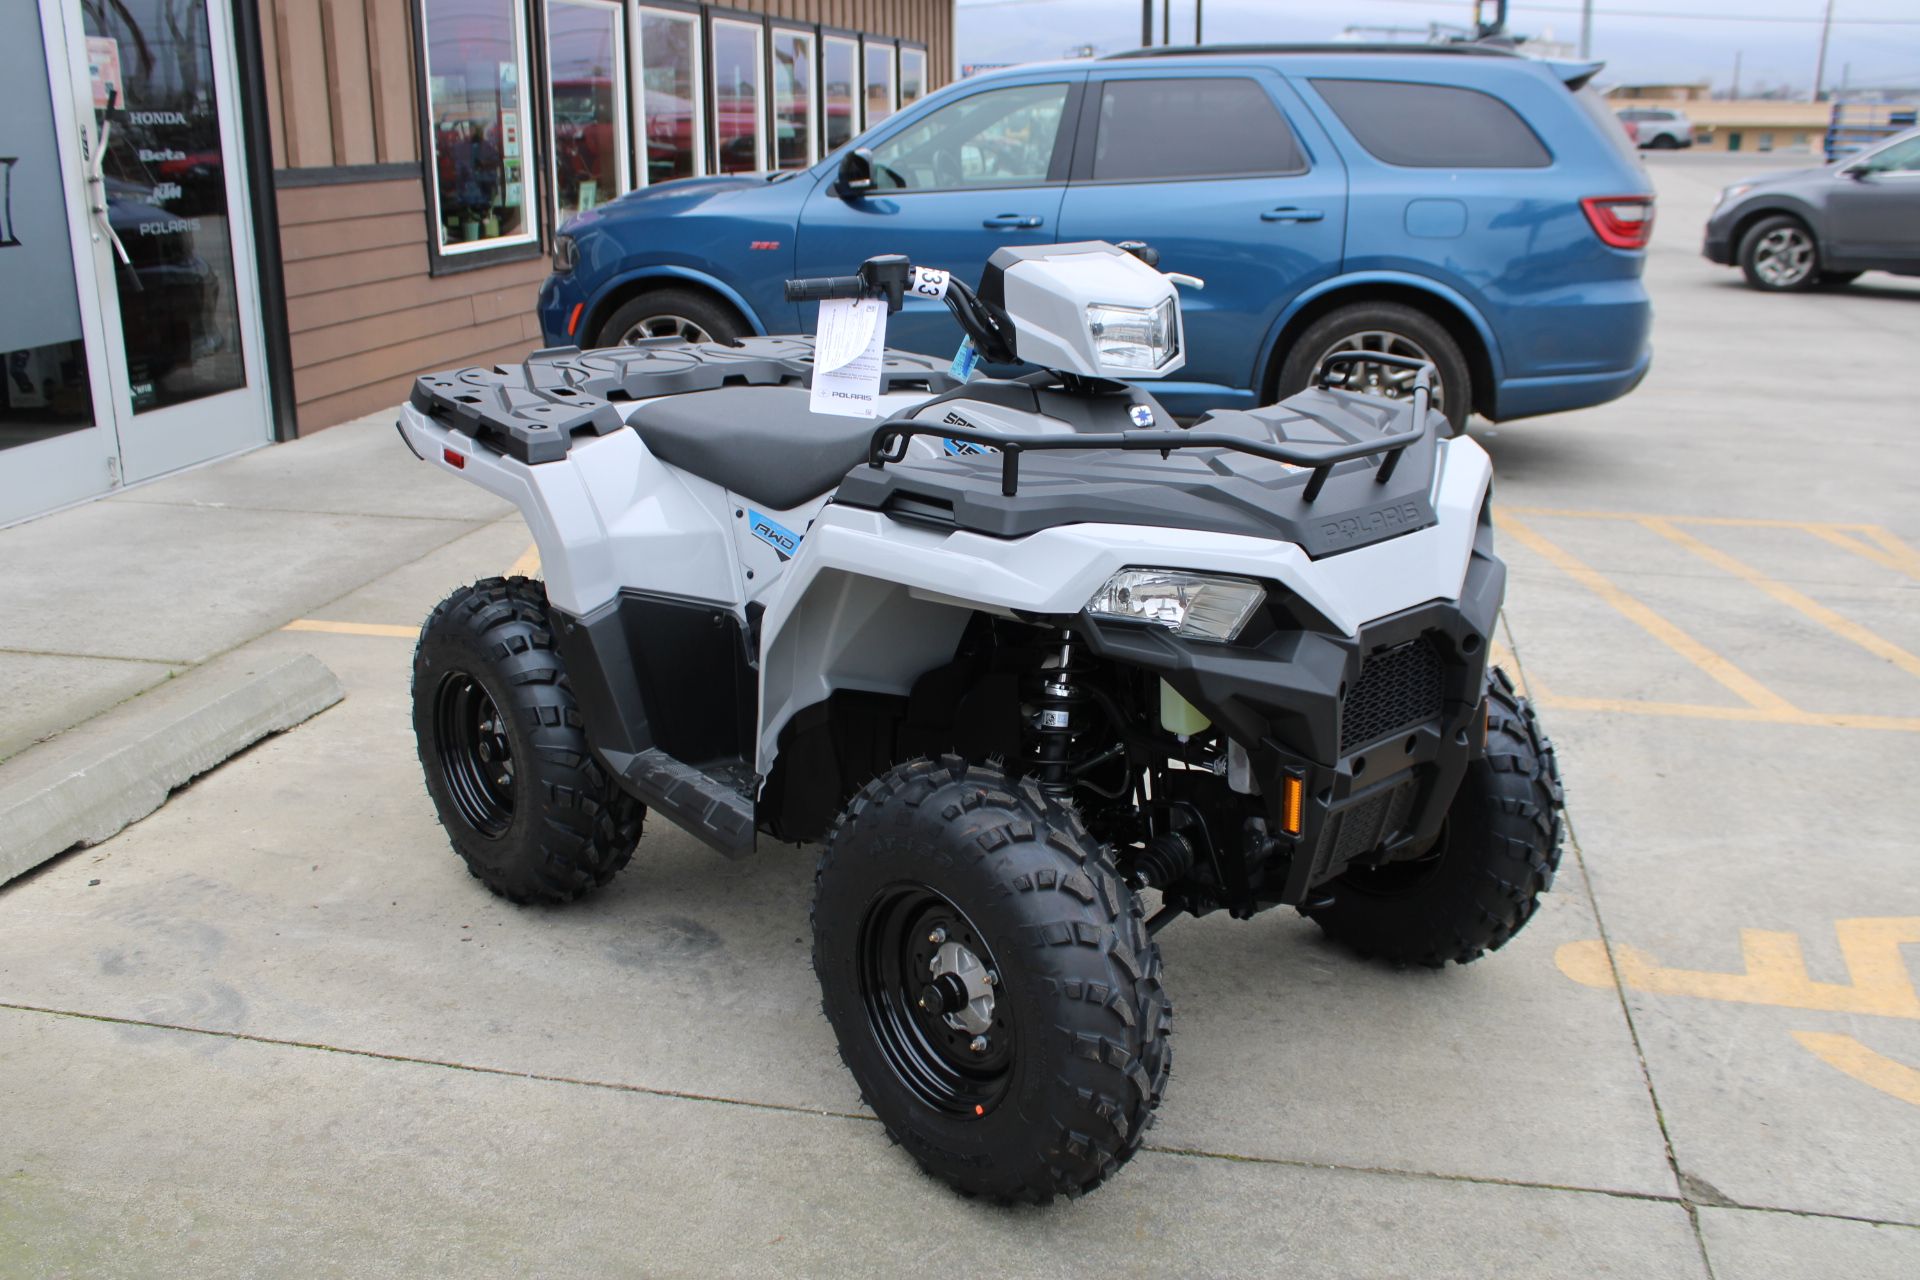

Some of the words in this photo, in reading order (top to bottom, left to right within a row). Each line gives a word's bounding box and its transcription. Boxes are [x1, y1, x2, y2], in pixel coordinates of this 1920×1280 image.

[129, 112, 187, 125] HONDA
[139, 148, 187, 162] Beta
[139, 218, 201, 237] POLARIS
[831, 391, 873, 402] POLARIS
[1320, 501, 1421, 545] POLARIS
[754, 522, 795, 550] AWD
